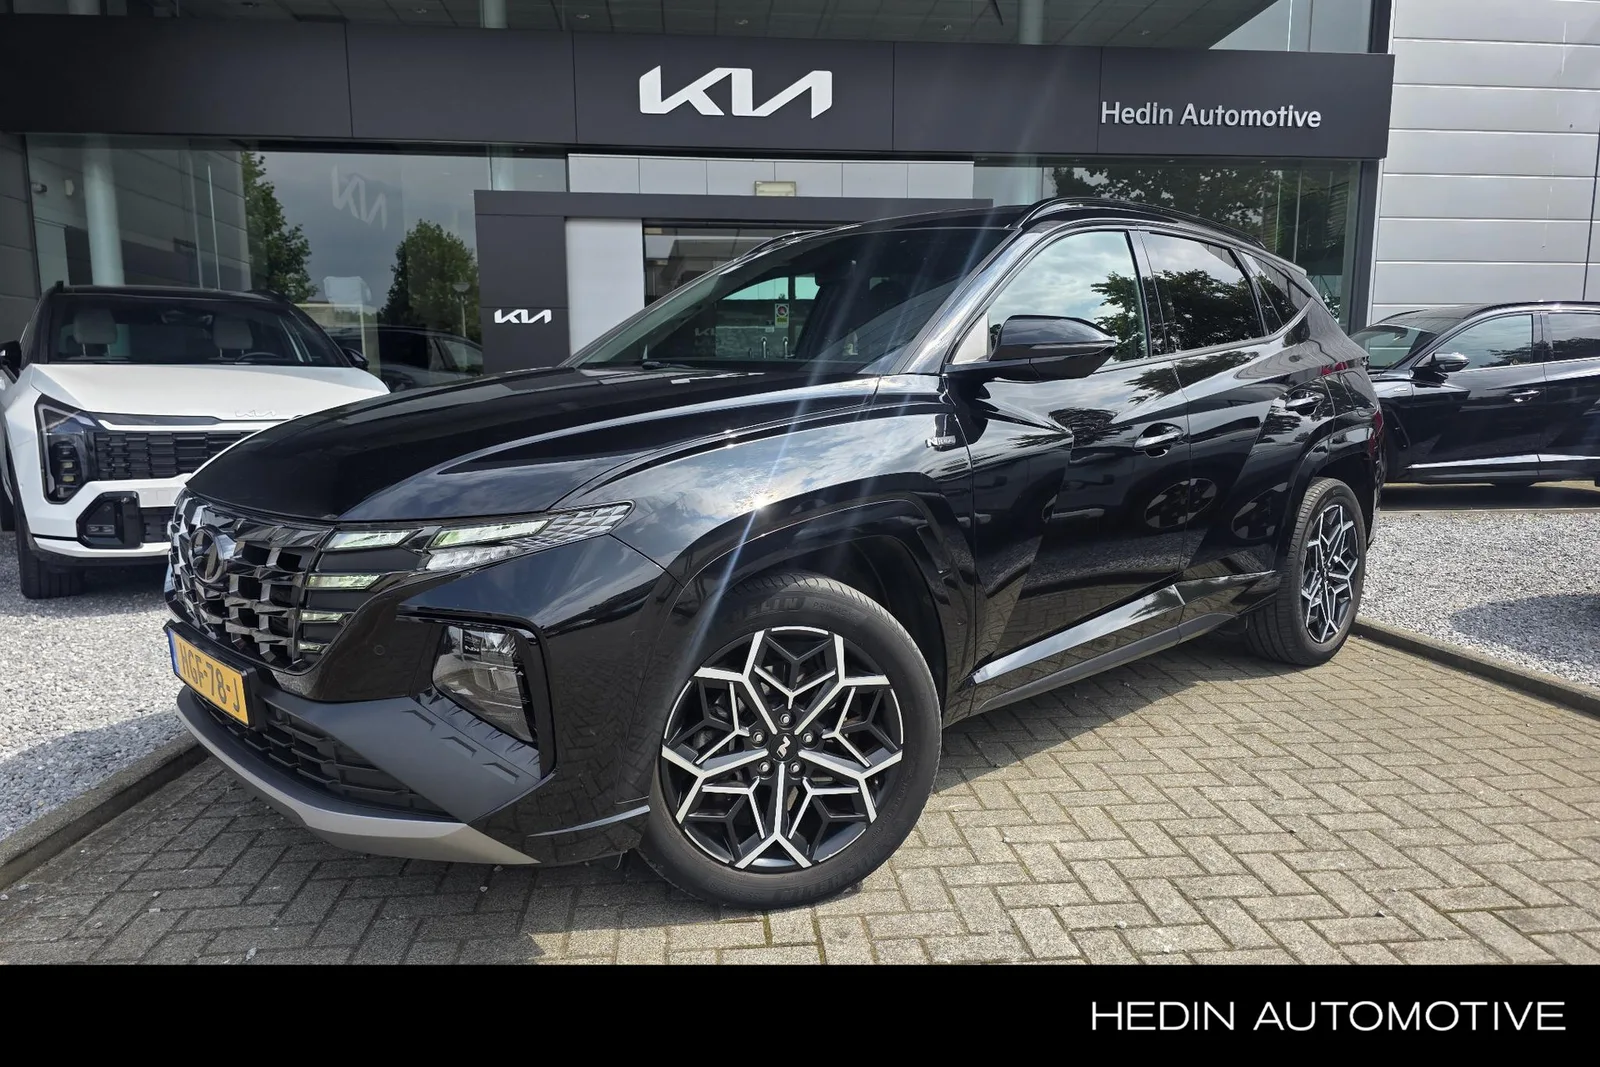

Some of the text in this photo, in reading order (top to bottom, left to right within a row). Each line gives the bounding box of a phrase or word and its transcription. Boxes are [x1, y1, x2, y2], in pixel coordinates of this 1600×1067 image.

[639, 65, 833, 119] KIA
[1101, 101, 1322, 128] Hedin Automotive
[494, 308, 552, 324] KIA
